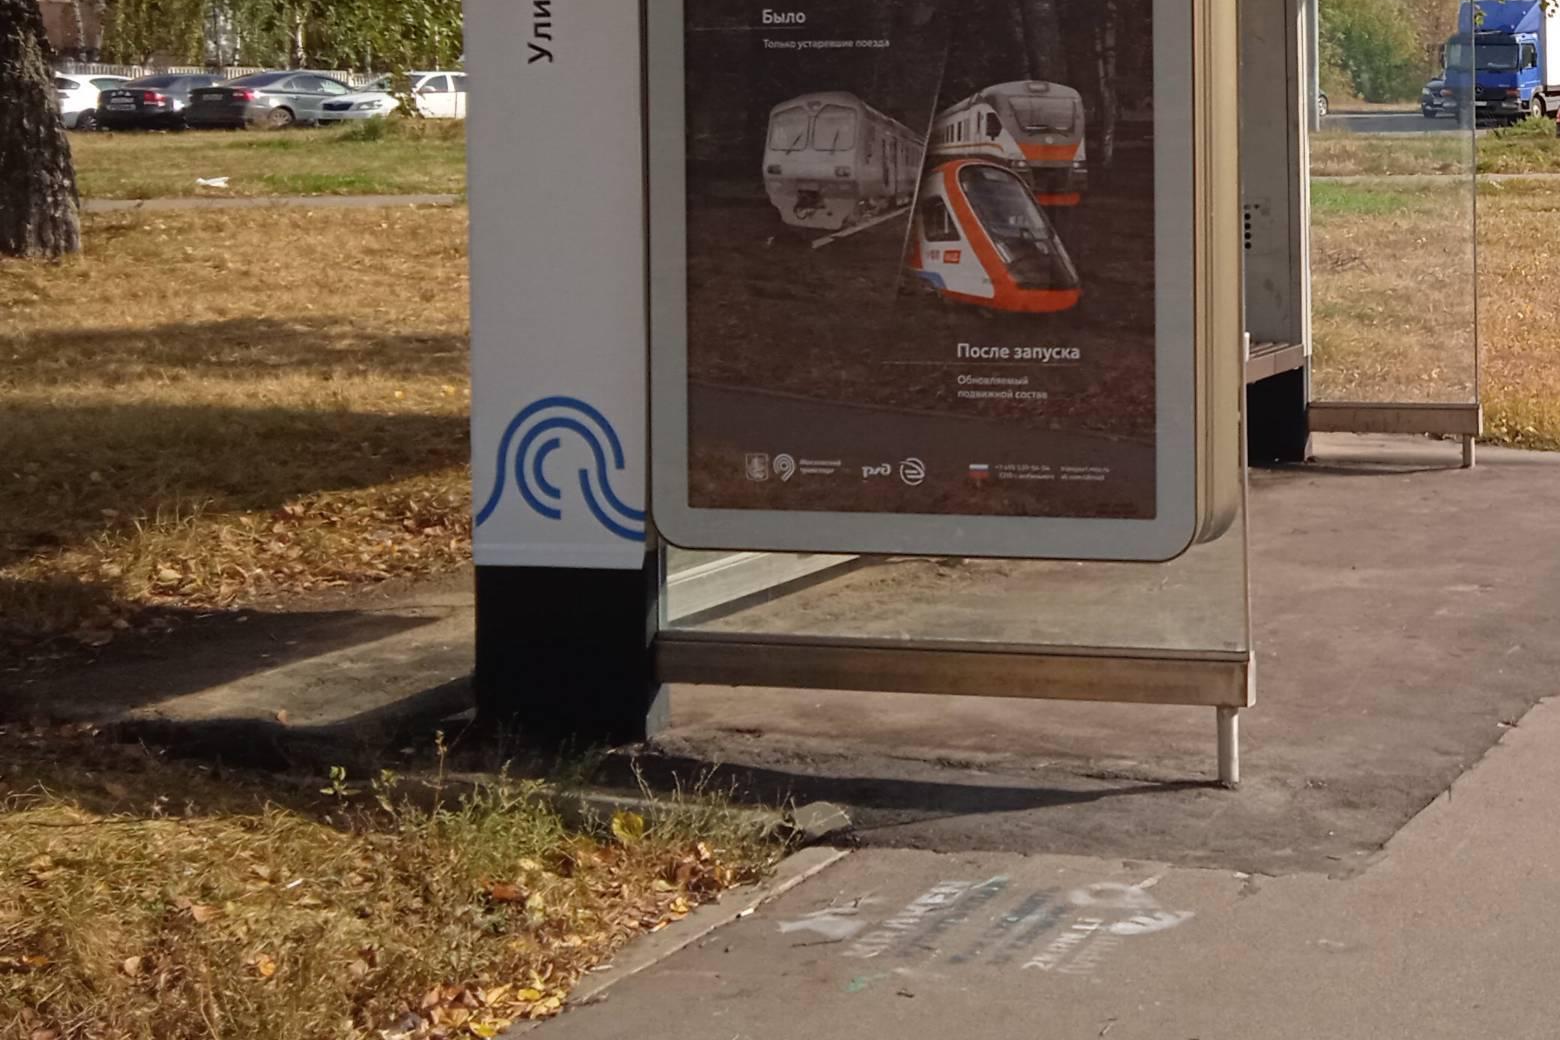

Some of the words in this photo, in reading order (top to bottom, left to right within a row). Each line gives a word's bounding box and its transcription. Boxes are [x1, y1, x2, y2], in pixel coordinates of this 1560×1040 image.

[761, 8, 807, 24] Было
[956, 342, 1010, 360] После
[1013, 346, 1081, 363] запуска
